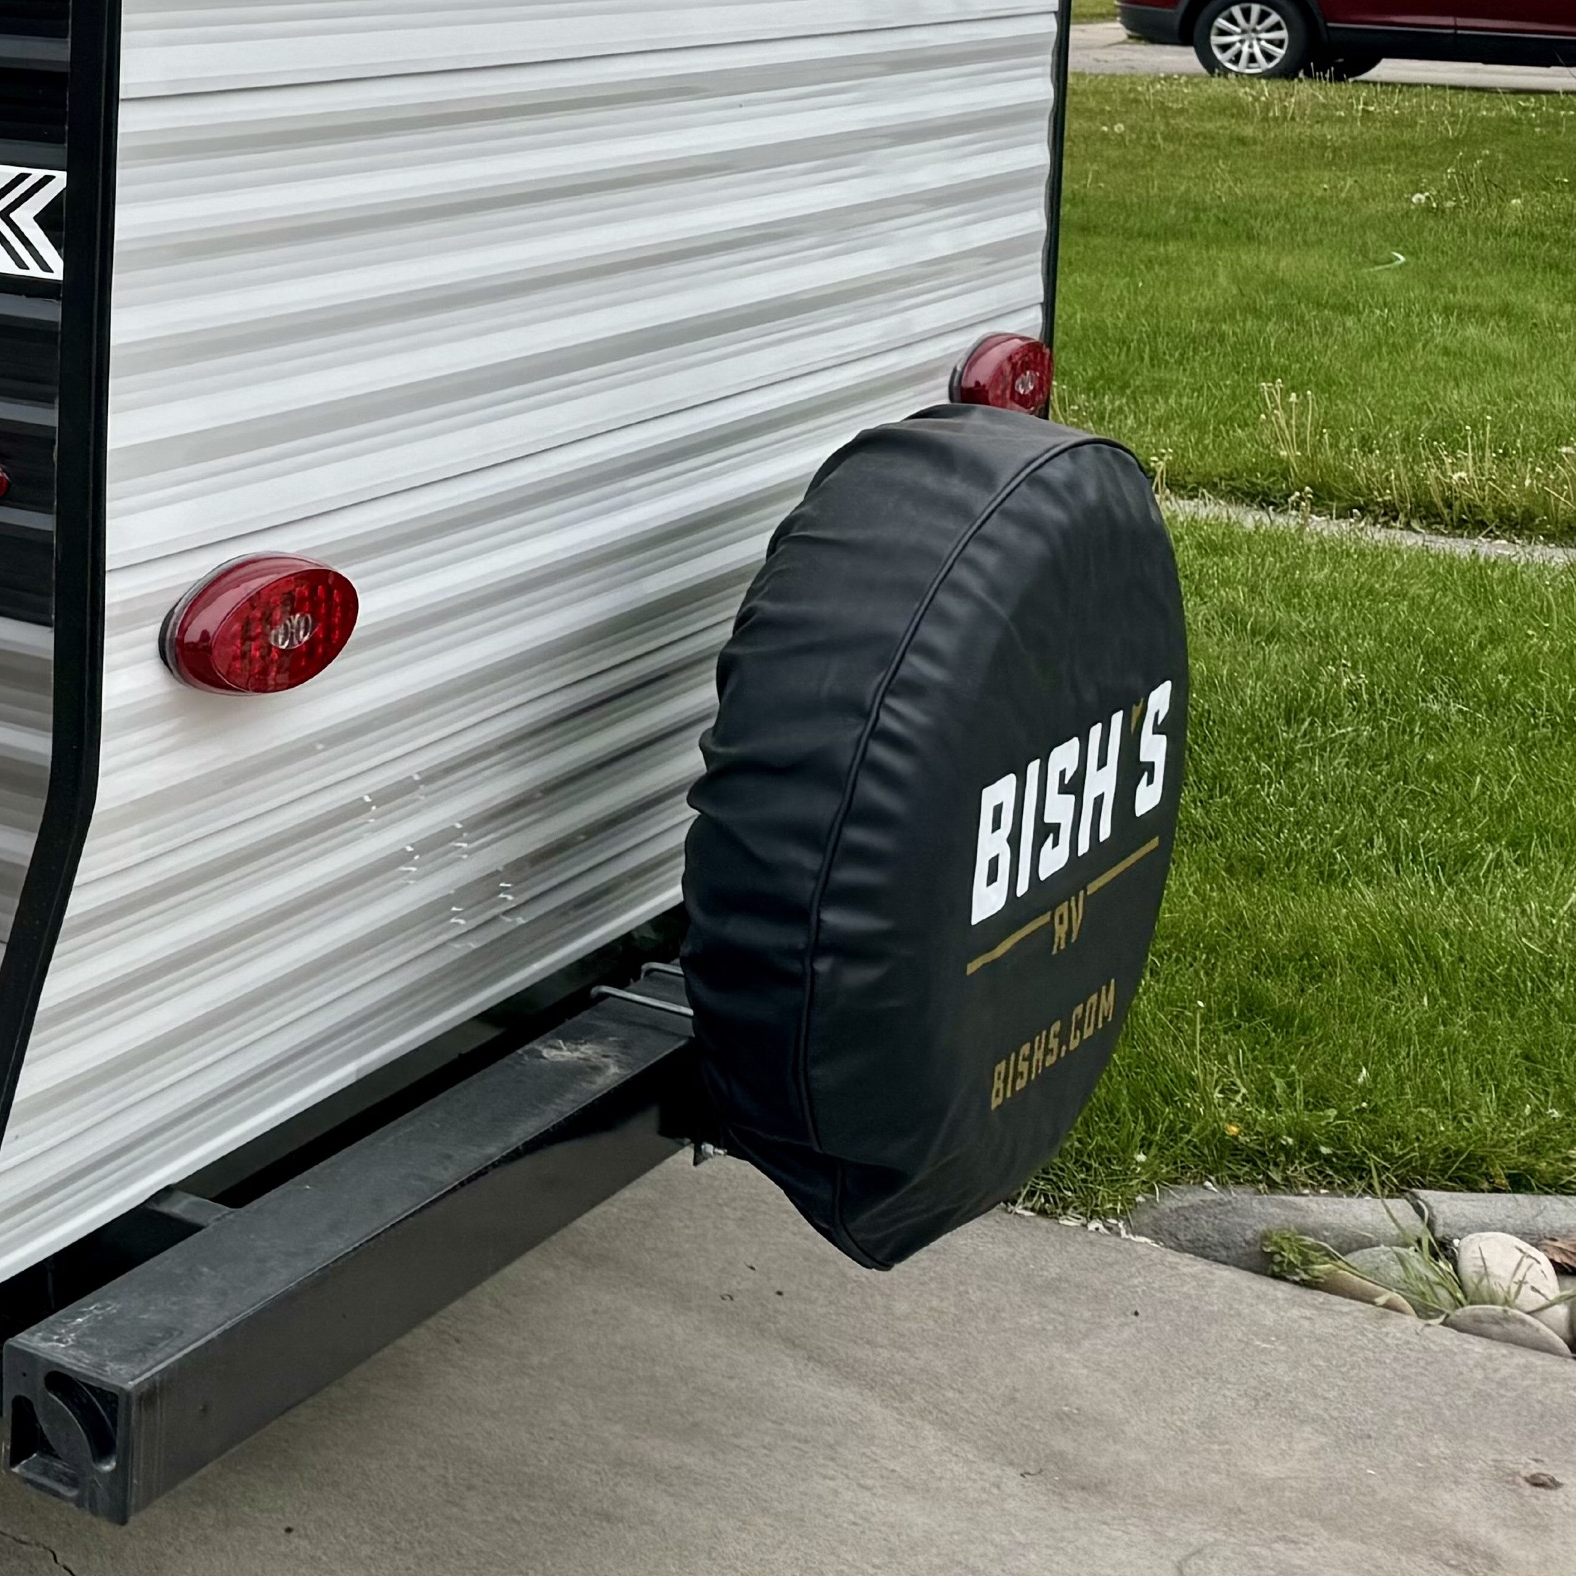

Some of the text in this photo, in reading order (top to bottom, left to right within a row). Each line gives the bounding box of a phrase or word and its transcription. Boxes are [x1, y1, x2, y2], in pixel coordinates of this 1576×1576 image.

[971, 680, 1172, 925] BISH'S
[1052, 890, 1086, 956] RV
[991, 978, 1116, 1111] BISHS.COM
